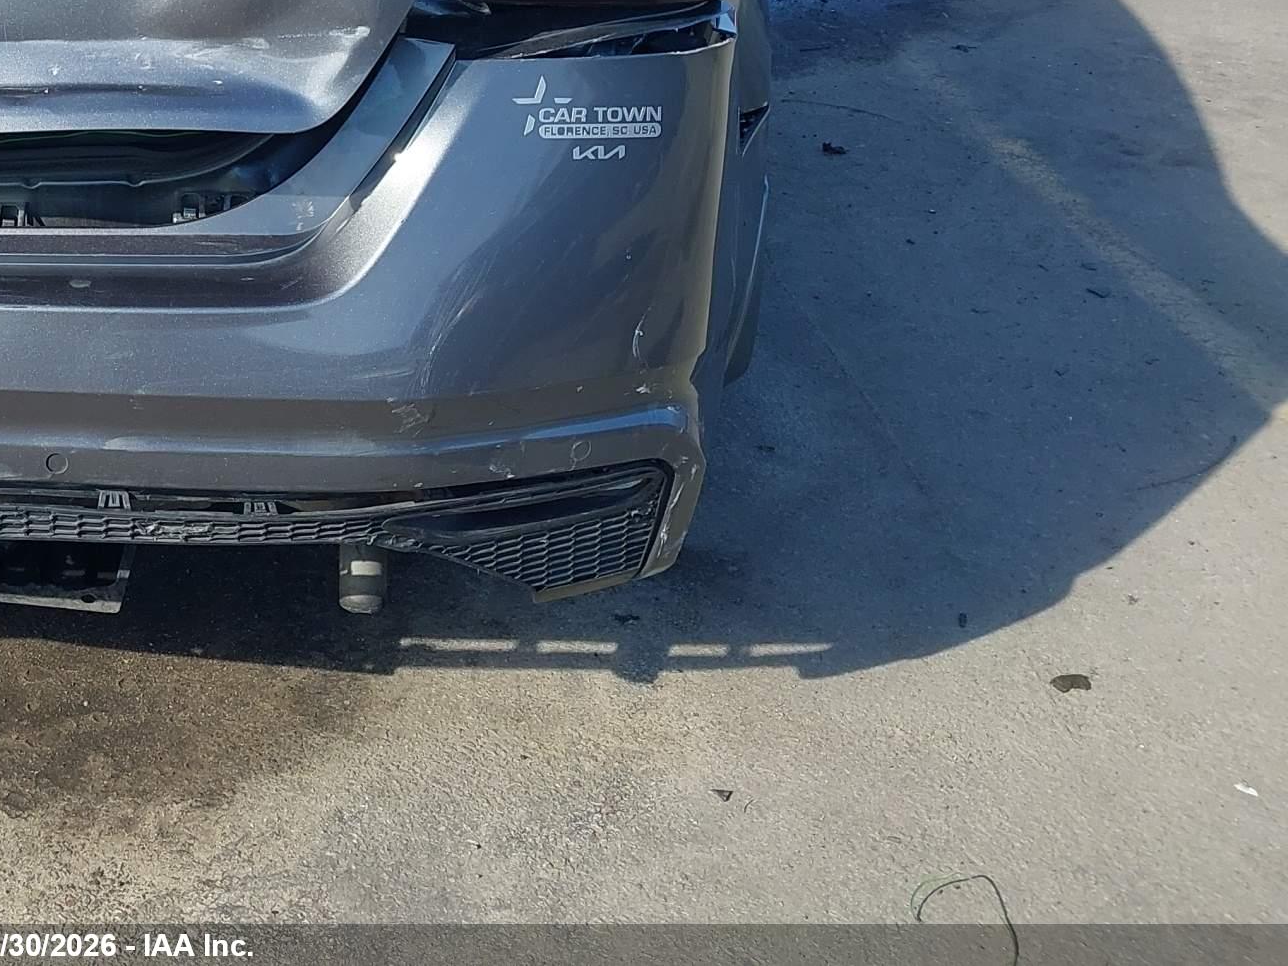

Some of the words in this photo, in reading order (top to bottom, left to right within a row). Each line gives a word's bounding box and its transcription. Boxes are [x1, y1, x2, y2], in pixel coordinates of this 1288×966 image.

[538, 107, 588, 123] CAR
[593, 106, 662, 123] TOWN
[543, 125, 610, 136] FLORENCE,
[612, 125, 628, 135] SC
[633, 125, 657, 135] USA
[572, 144, 626, 160] KIA
